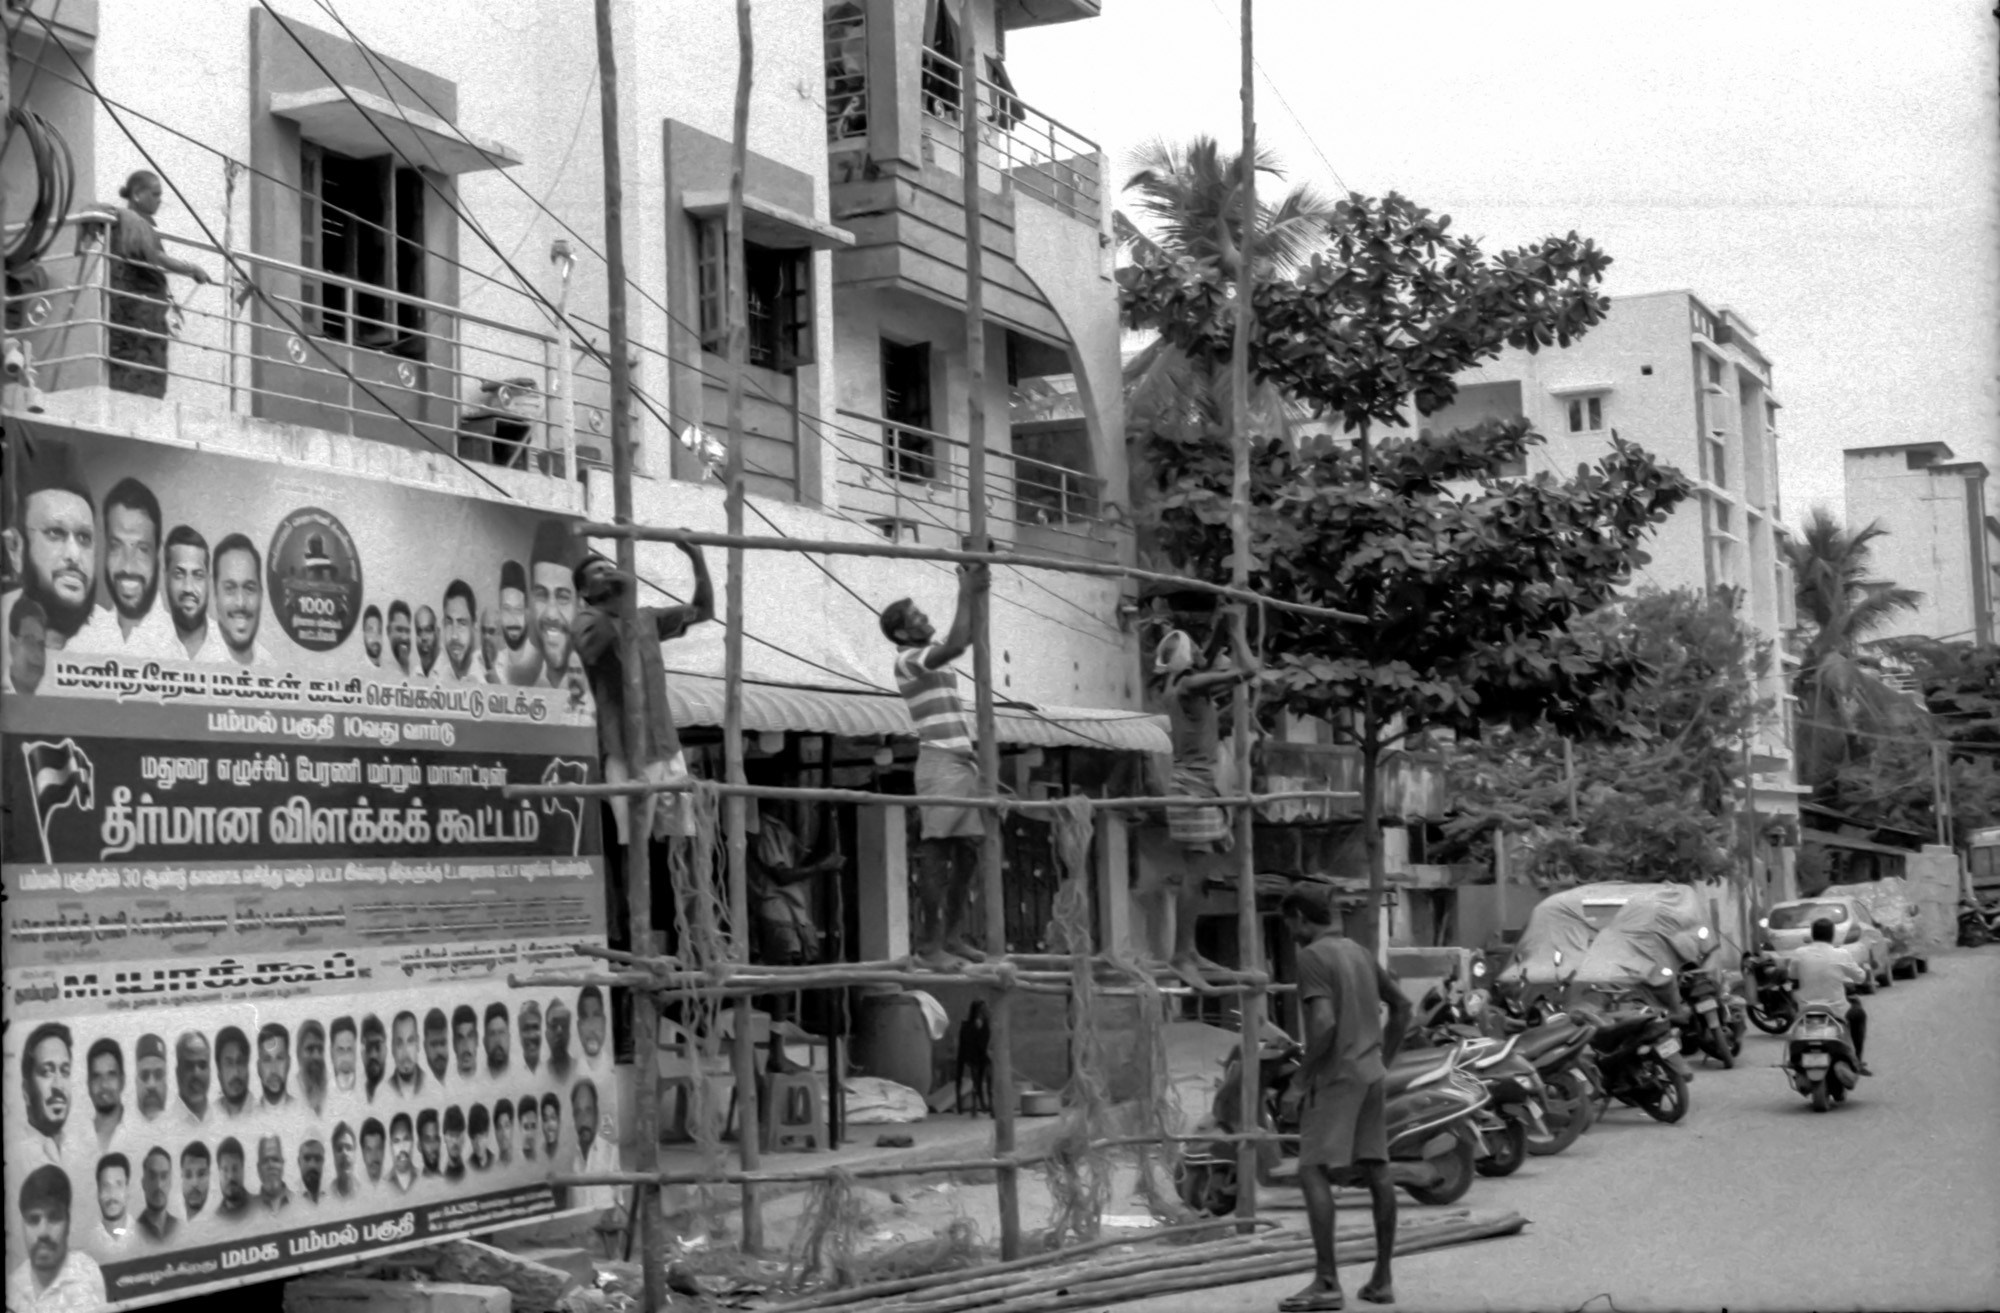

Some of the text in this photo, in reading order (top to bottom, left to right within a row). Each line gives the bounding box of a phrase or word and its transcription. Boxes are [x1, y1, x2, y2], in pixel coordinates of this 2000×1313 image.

[299, 596, 336, 616] 1000
[56, 660, 547, 720] மனிதநேய மக்கள் கட்சி செங்கல்பட்டு வடக்கு
[207, 708, 456, 747] பம்மல் பகுதி 10வது வார்டு
[141, 755, 209, 789] மதுரை
[216, 751, 290, 787] எழுச்சிப்
[296, 755, 362, 788] பேரணி
[367, 755, 422, 793] மற்றும்
[101, 785, 540, 861] தீர்மான விளக்கக் கூட்டம்
[220, 1241, 280, 1270] மமக
[288, 1223, 359, 1257] பம்மல்
[362, 1212, 416, 1243] பகுதி
